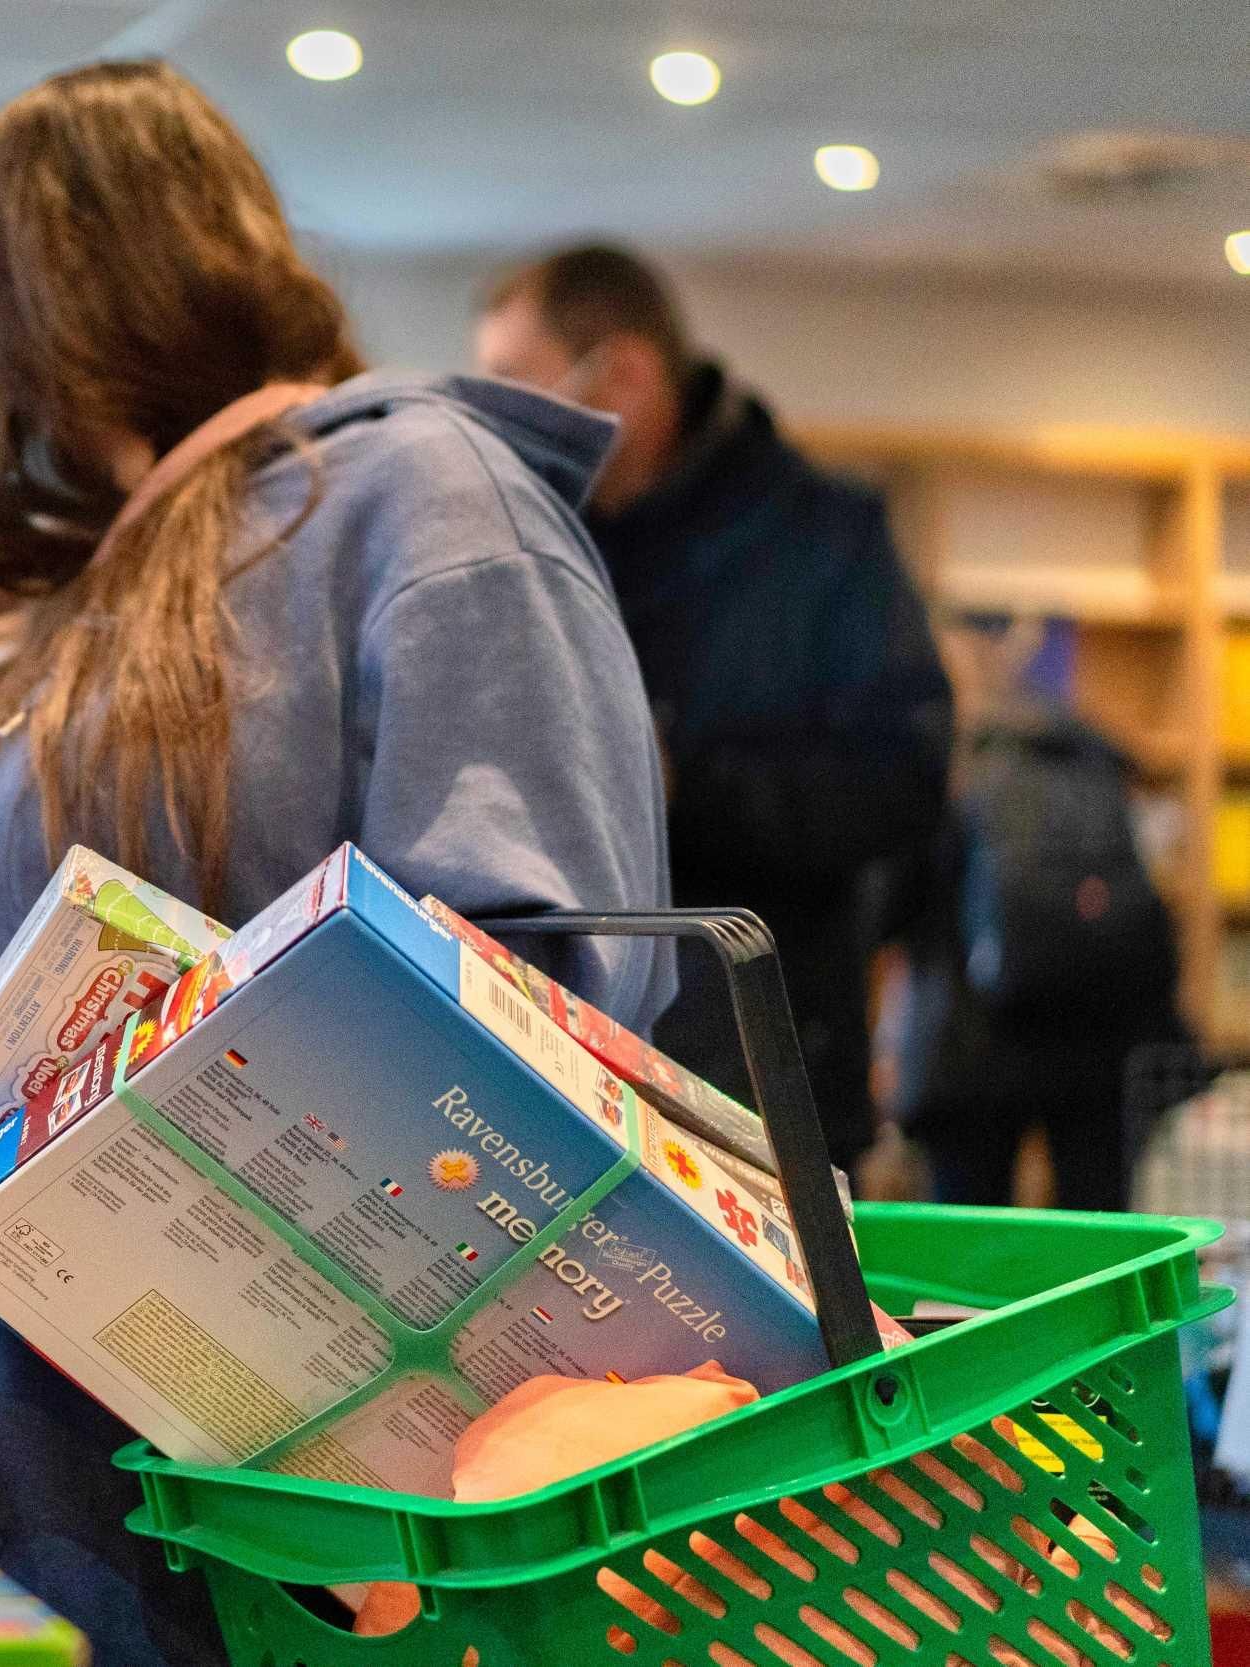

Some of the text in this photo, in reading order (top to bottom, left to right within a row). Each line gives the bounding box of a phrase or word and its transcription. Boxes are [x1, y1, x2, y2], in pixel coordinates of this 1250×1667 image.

[354, 848, 454, 942] Ravensburger
[8, 1001, 42, 1046] ATTENTION
[59, 969, 122, 1048] Christmas
[28, 1060, 58, 1095] Noël
[84, 1042, 107, 1106] memory
[432, 1083, 618, 1249] Ravensburer
[636, 1262, 727, 1344] Puzzle
[476, 1191, 625, 1320] memory
